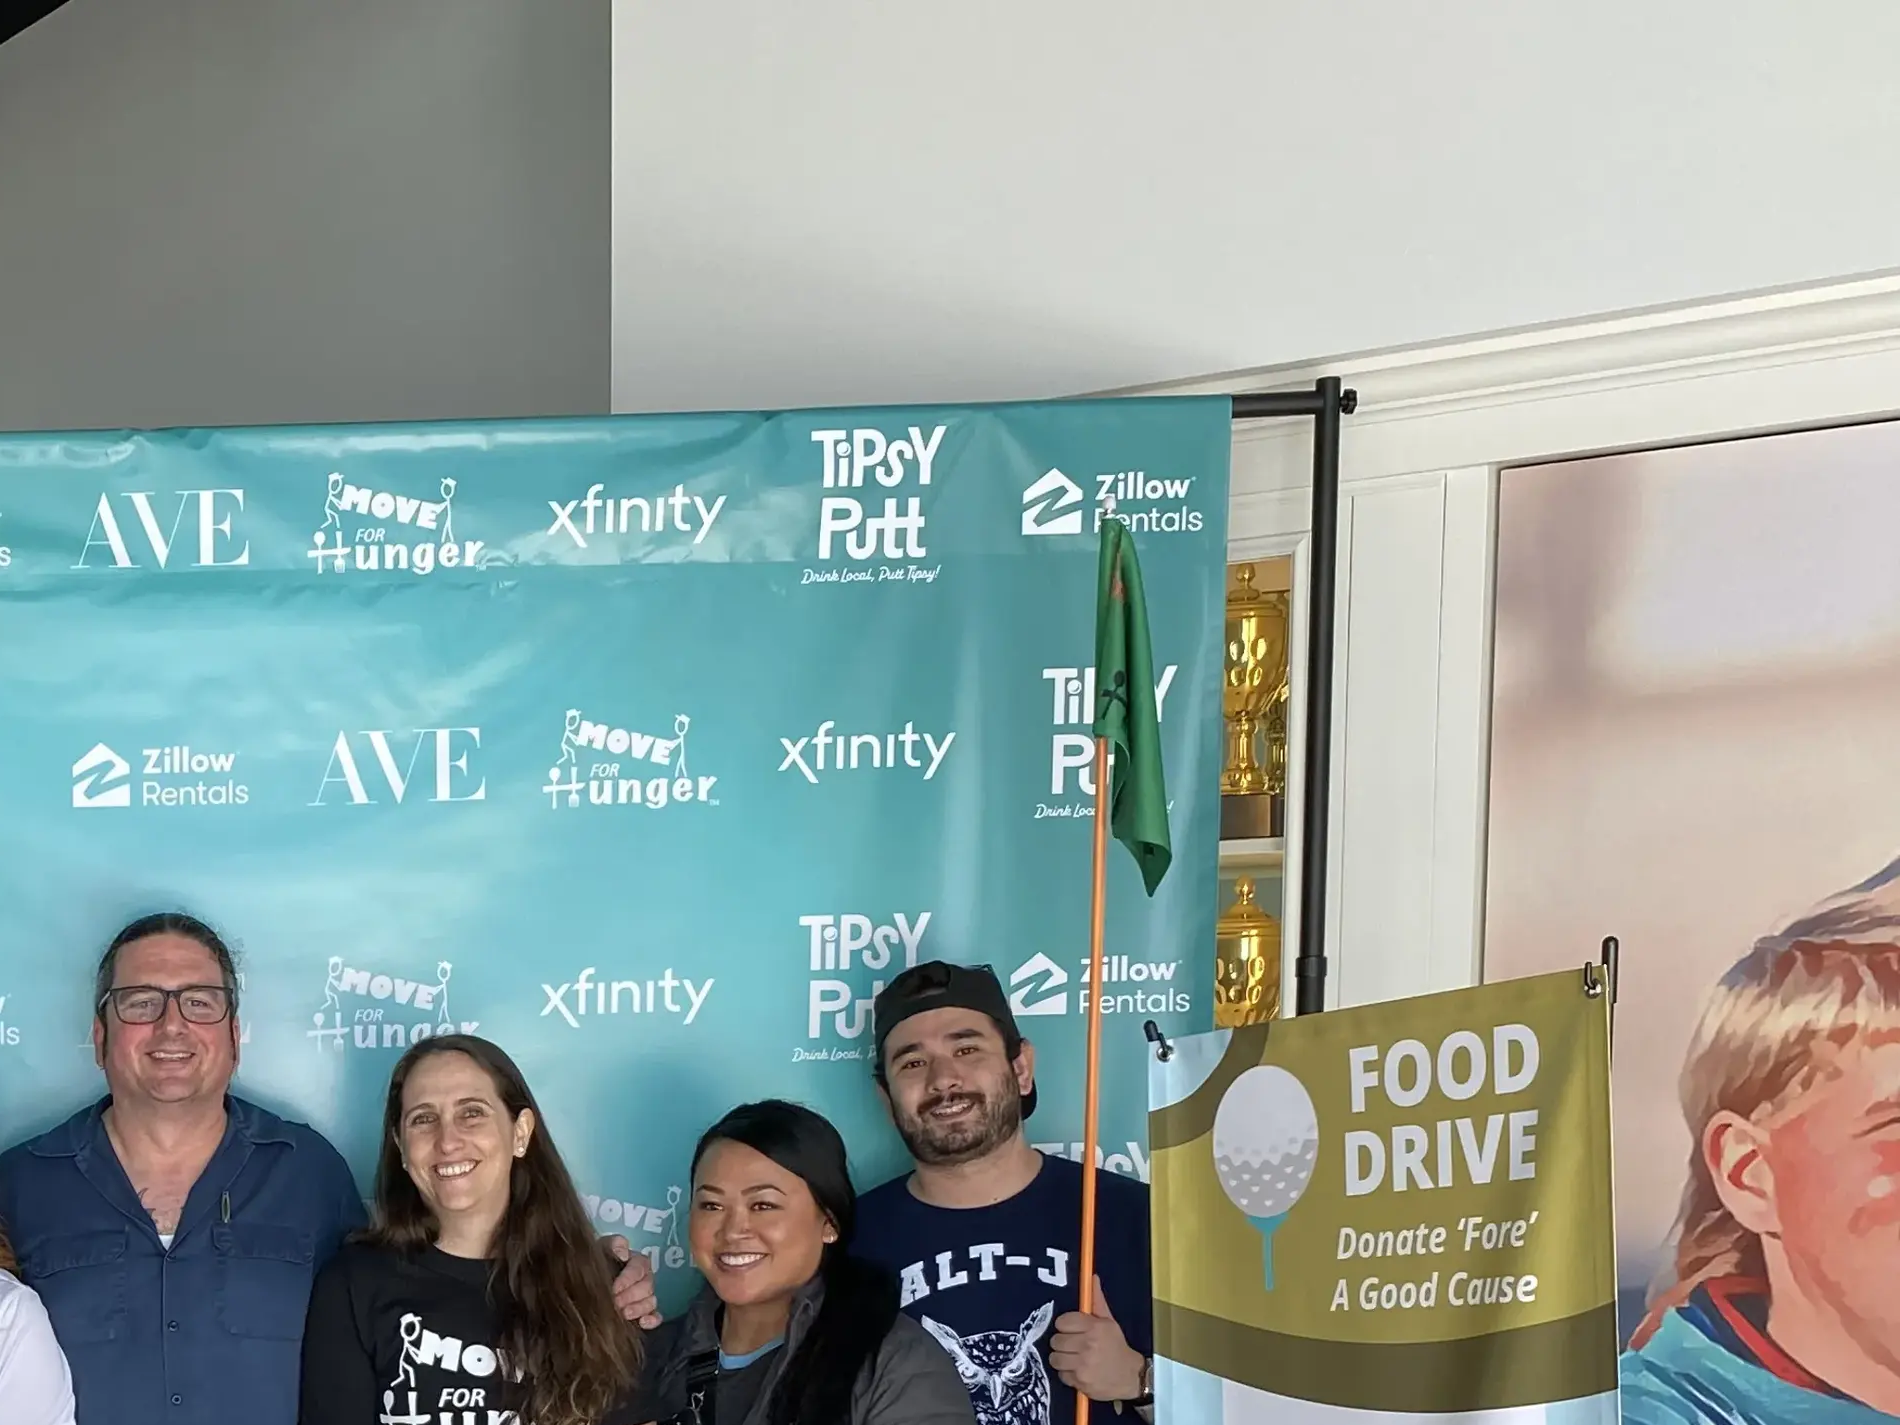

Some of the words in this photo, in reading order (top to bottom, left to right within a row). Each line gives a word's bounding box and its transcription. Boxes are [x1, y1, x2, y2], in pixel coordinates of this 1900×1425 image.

[70, 489, 250, 569] AVE
[339, 485, 440, 531] MOVE
[547, 482, 727, 549] xfinity
[356, 528, 385, 542] FOR
[141, 746, 237, 775] Zillow
[142, 780, 249, 806] Rentals
[540, 967, 715, 1028] xfinity
[1349, 1023, 1539, 1113] FOOD
[1344, 1110, 1539, 1196] DRIVE
[1337, 1227, 1446, 1260] Donate
[900, 1243, 1069, 1308] ALT-J
[1330, 1279, 1349, 1311] A
[1359, 1276, 1437, 1310] Good
[1448, 1273, 1538, 1307] Cause
[439, 1388, 486, 1407] FOR
